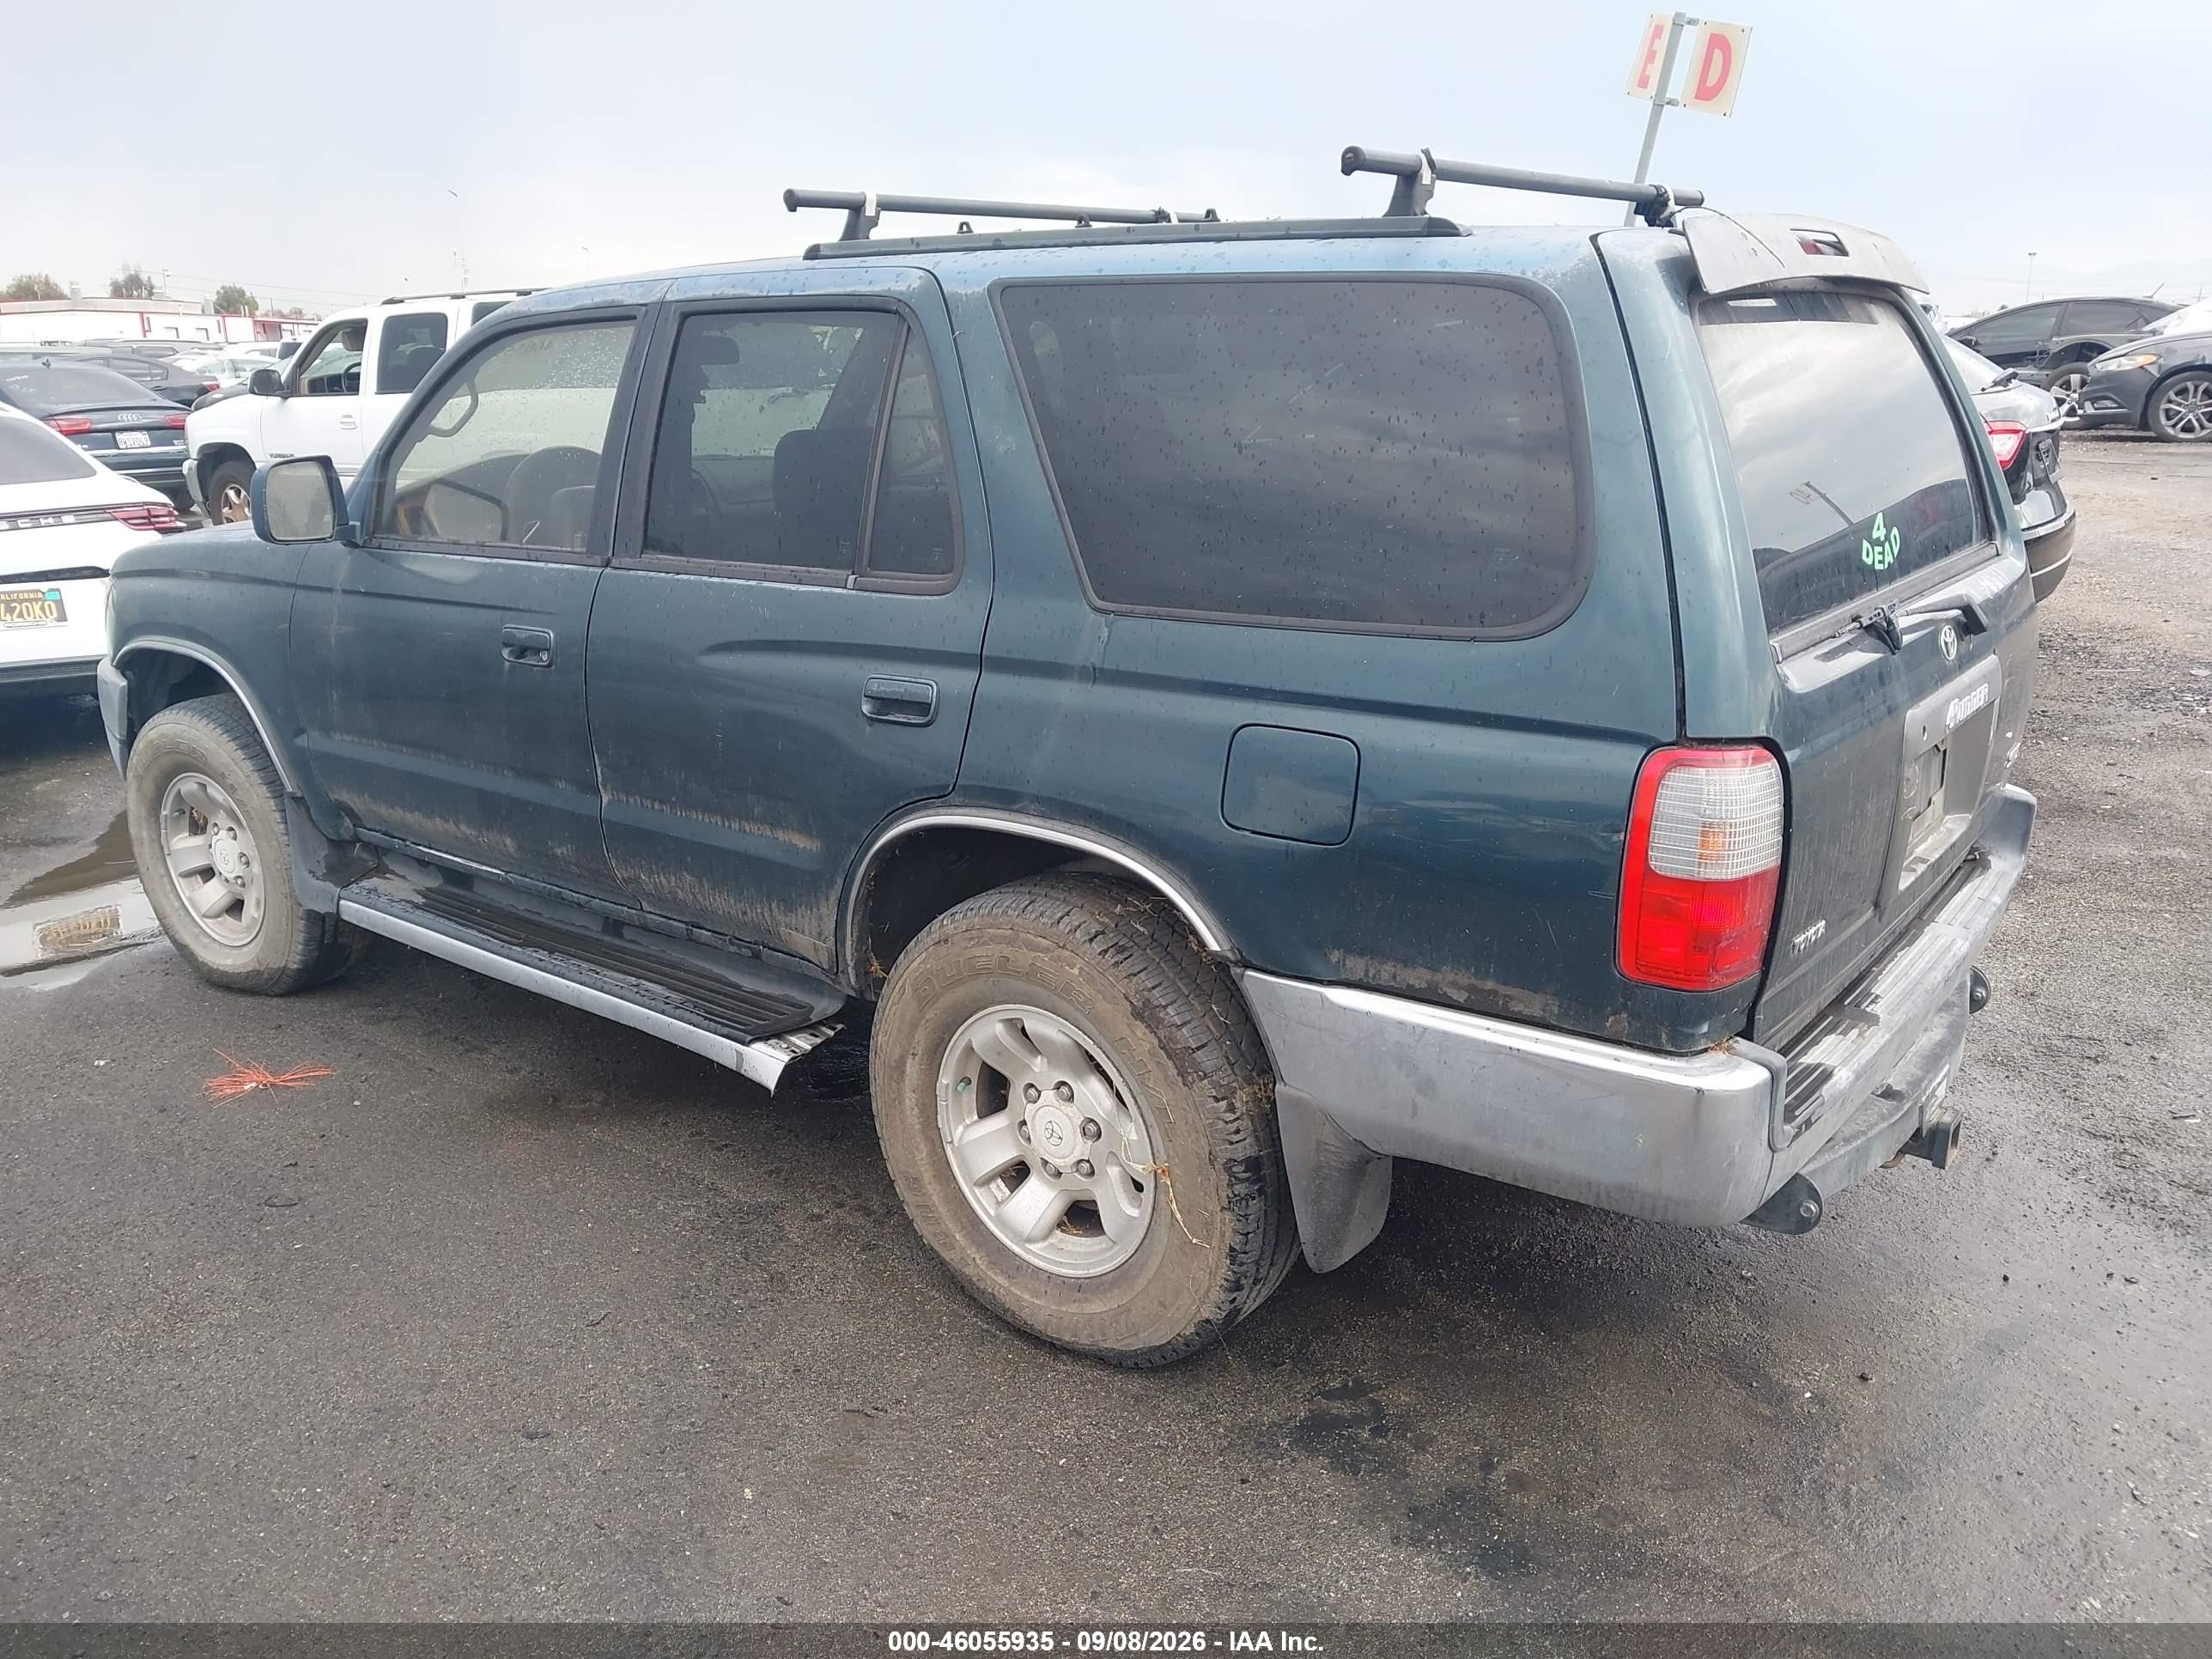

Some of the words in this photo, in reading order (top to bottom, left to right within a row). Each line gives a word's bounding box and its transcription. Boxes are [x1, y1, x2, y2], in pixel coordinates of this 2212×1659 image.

[1637, 24, 1664, 88] E
[1694, 33, 1732, 101] D
[1862, 526, 1901, 570] DEAD
[1872, 512, 1887, 541] 4
[911, 954, 1096, 1016] DUELER
